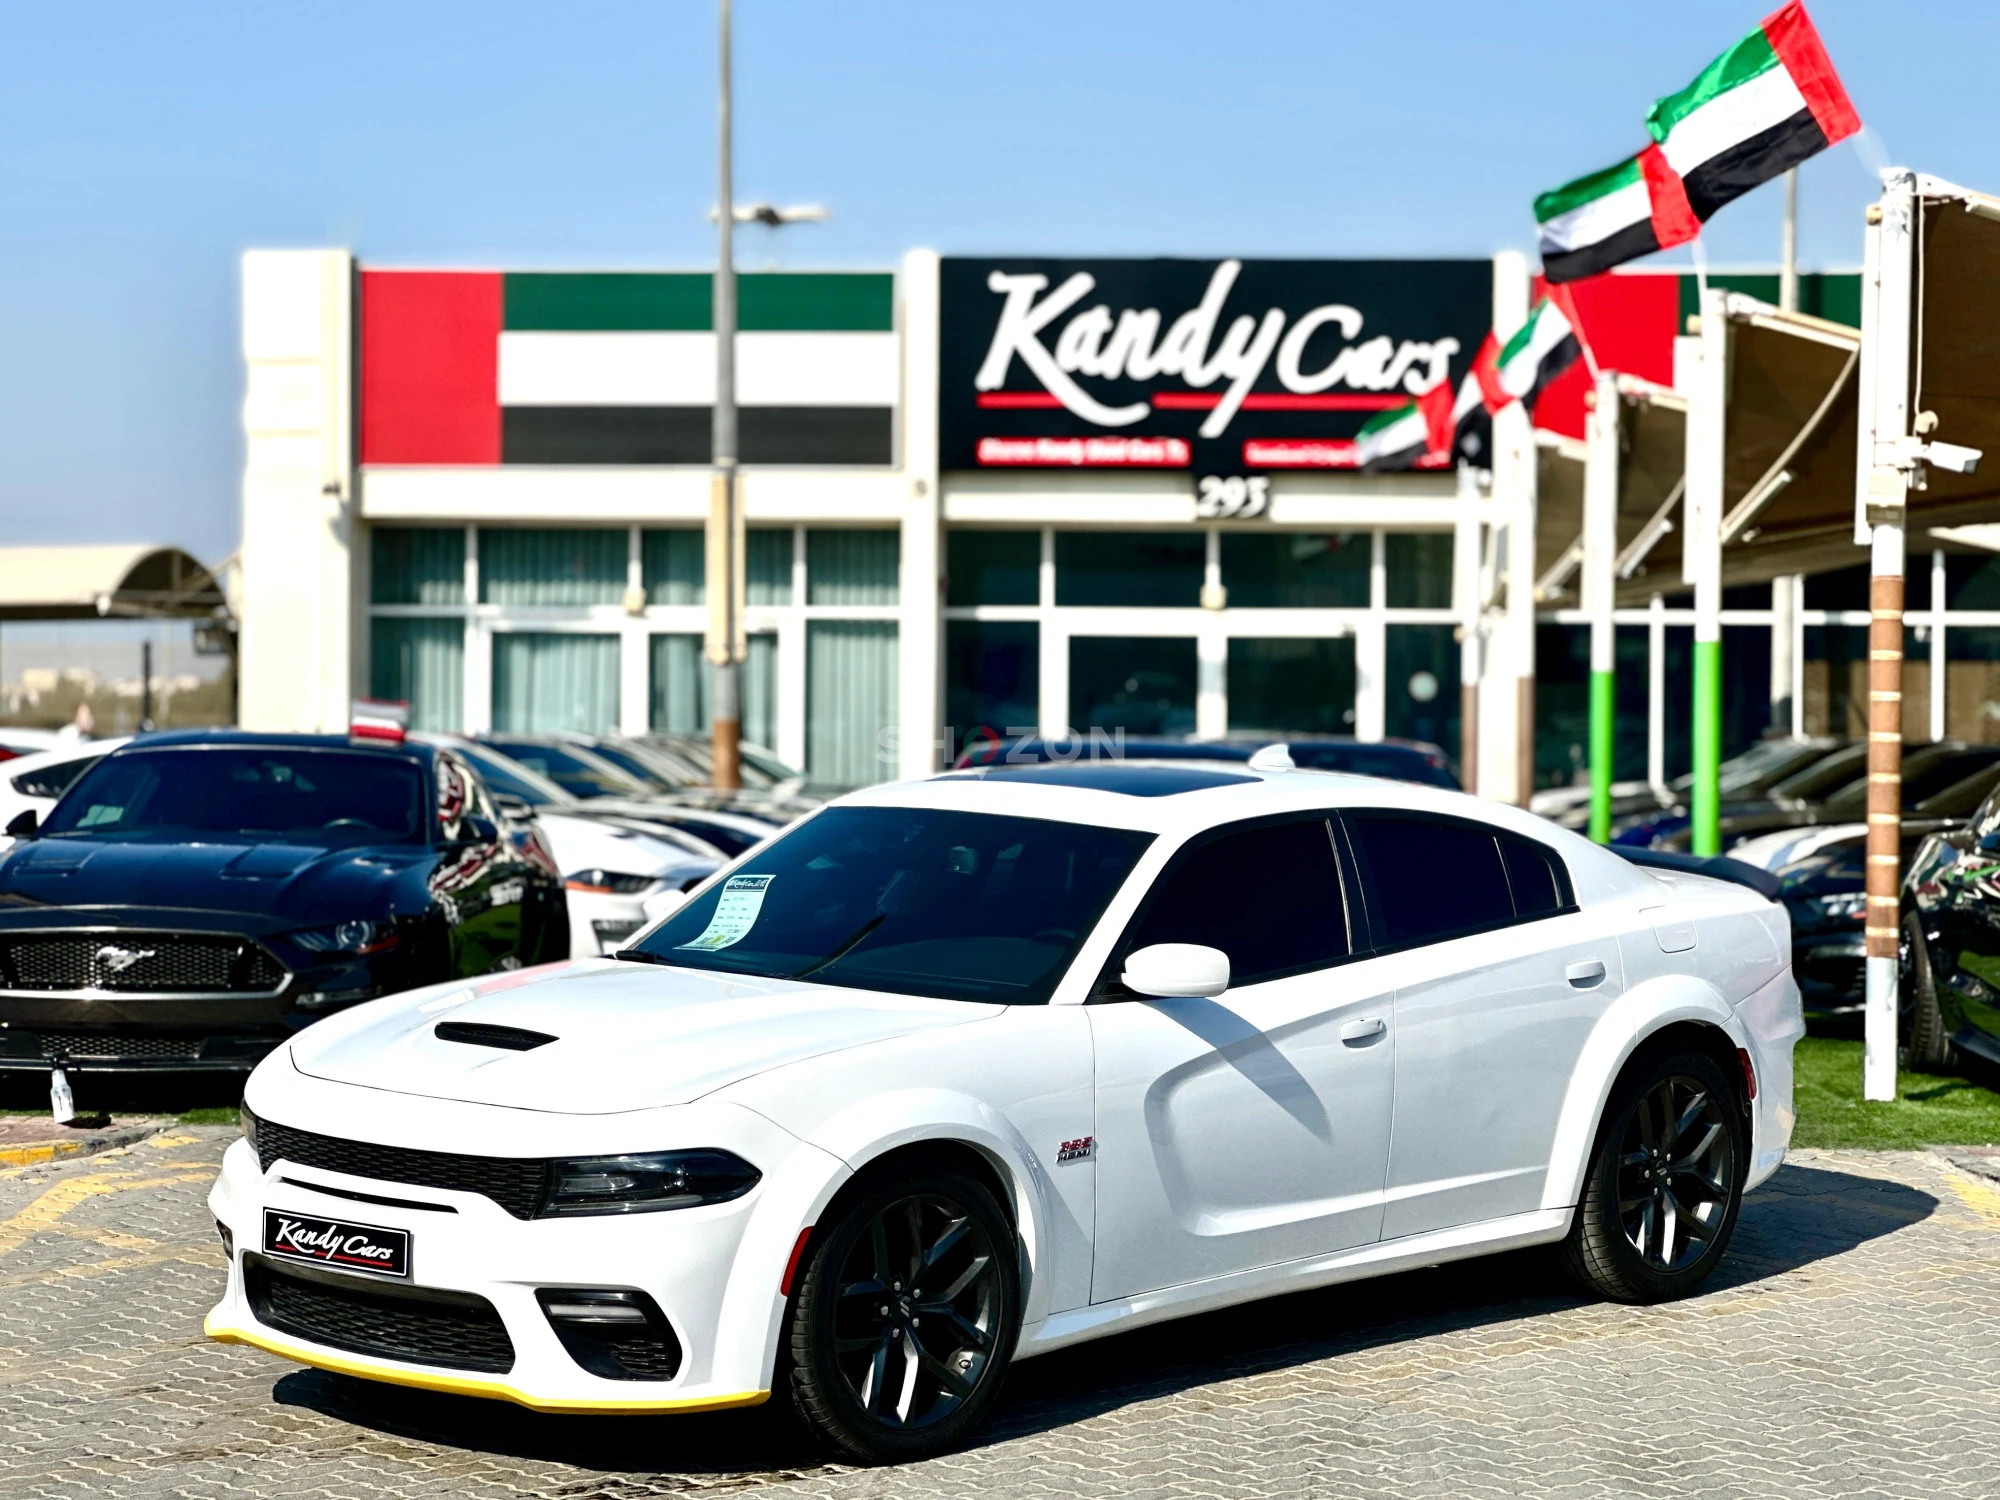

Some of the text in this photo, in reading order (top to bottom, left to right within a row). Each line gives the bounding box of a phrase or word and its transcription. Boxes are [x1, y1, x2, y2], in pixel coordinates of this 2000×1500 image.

[975, 258, 1460, 438] Kandy Cars
[275, 1217, 394, 1260] Kandy Cars
